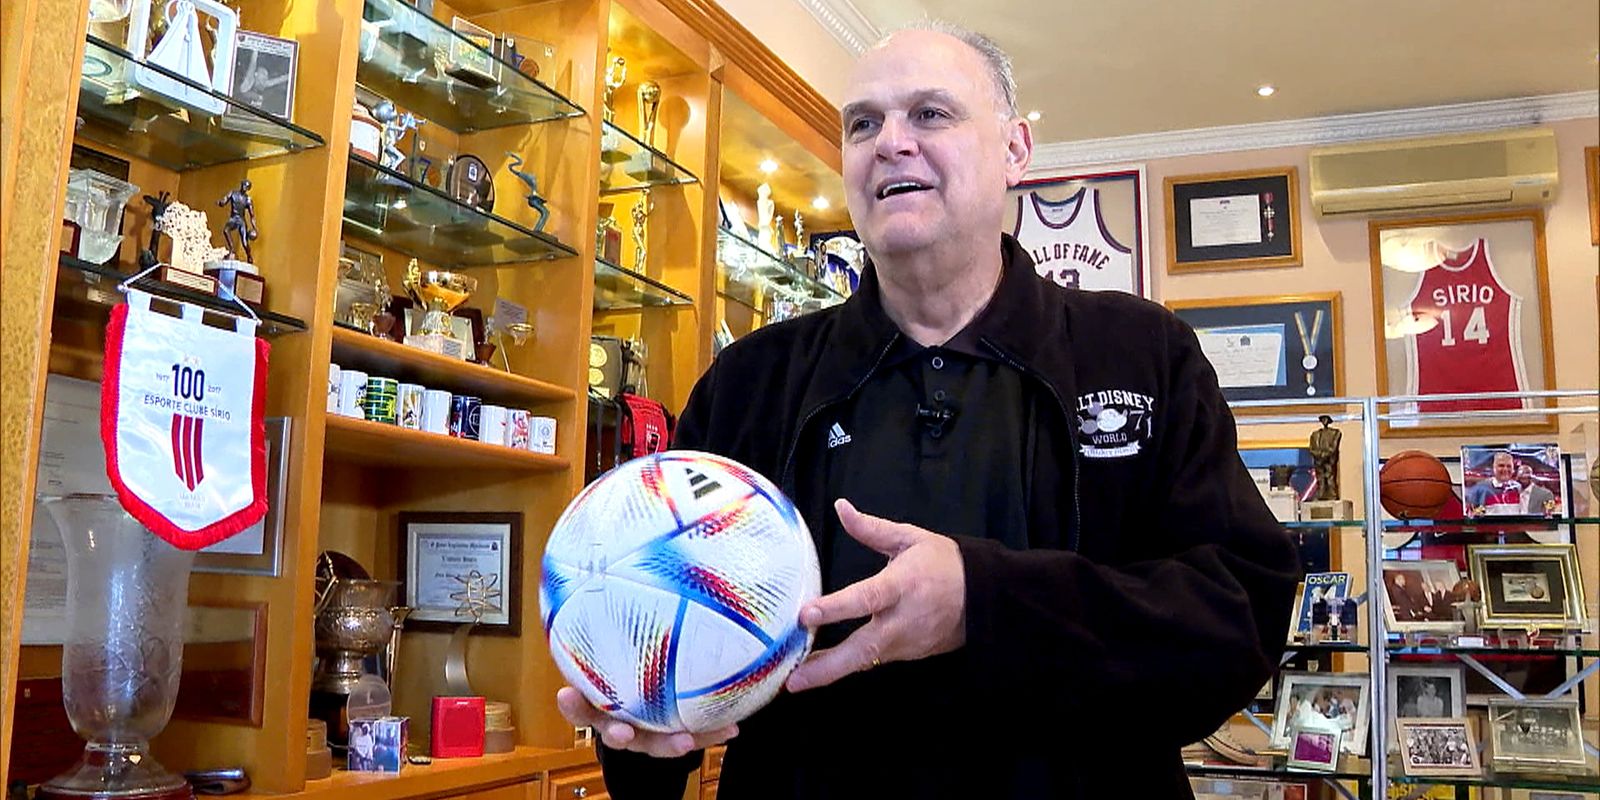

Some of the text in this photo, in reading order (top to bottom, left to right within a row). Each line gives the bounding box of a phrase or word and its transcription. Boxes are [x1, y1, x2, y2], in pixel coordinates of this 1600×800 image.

[1033, 243, 1110, 270] LL OF FAME
[1432, 283, 1494, 306] SIRIO
[1440, 306, 1490, 347] 14
[171, 363, 205, 402] 100
[144, 394, 231, 421] ESPORTE CLUBE SÍRIO
[1076, 390, 1154, 412] LT DISNEY
[1091, 432, 1127, 445] WORLD
[1308, 575, 1346, 585] OSCAR
